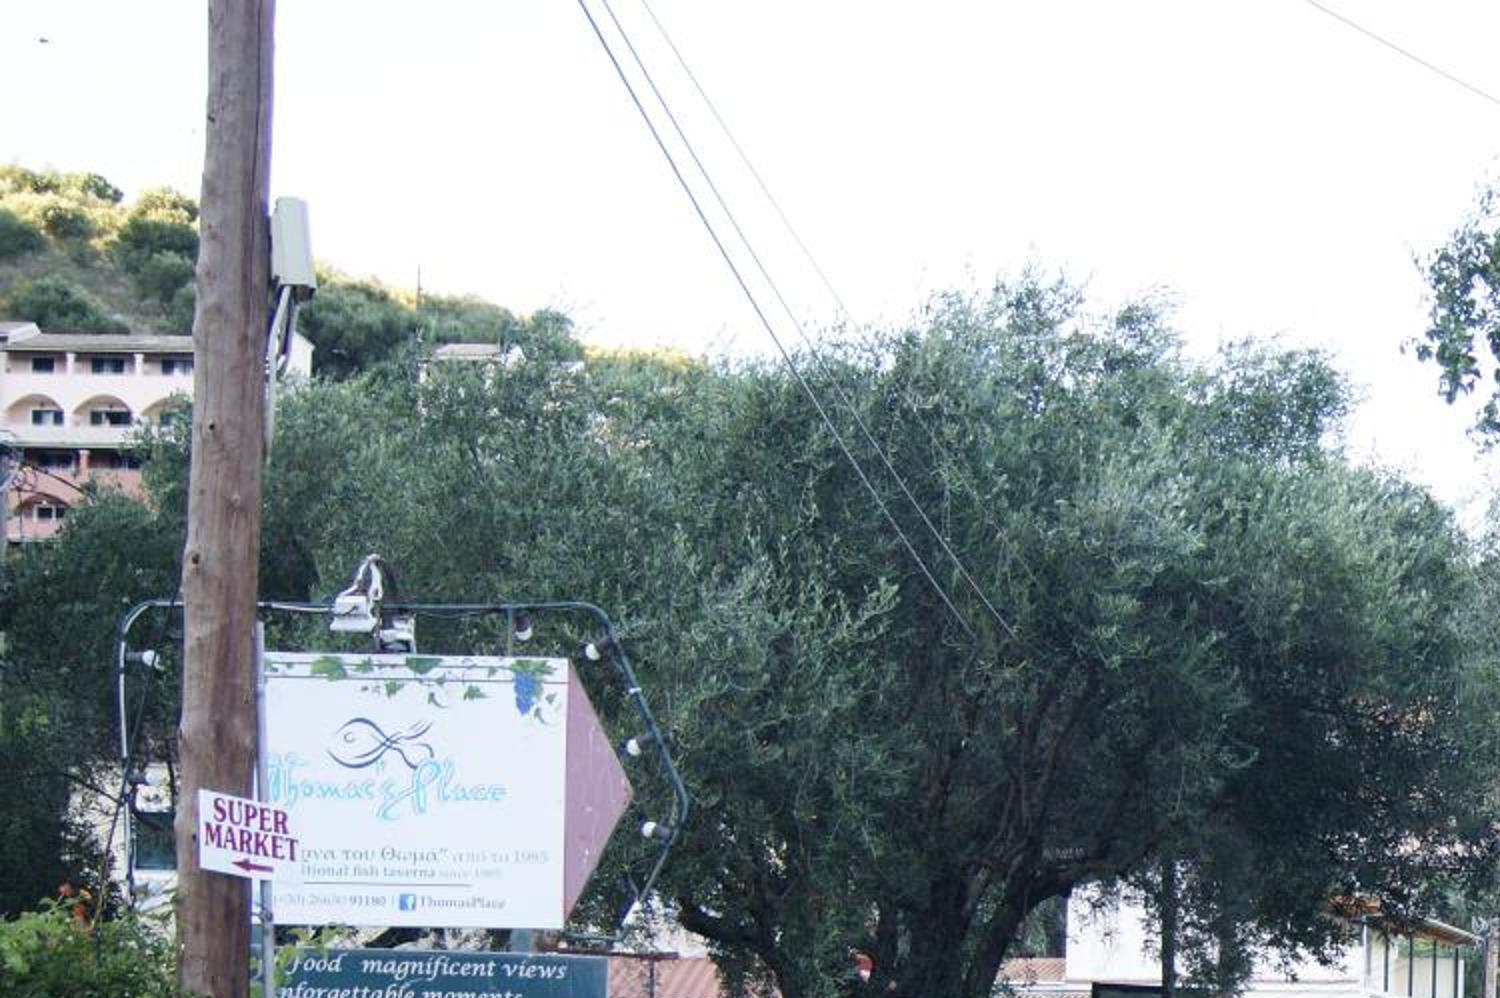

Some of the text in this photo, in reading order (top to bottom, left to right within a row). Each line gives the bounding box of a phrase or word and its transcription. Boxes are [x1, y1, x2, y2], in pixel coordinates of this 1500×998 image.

[411, 757, 508, 815] Place
[213, 797, 288, 834] SUPER
[203, 821, 299, 862] MARKET
[360, 952, 495, 980] magnificent
[502, 957, 567, 981] views
